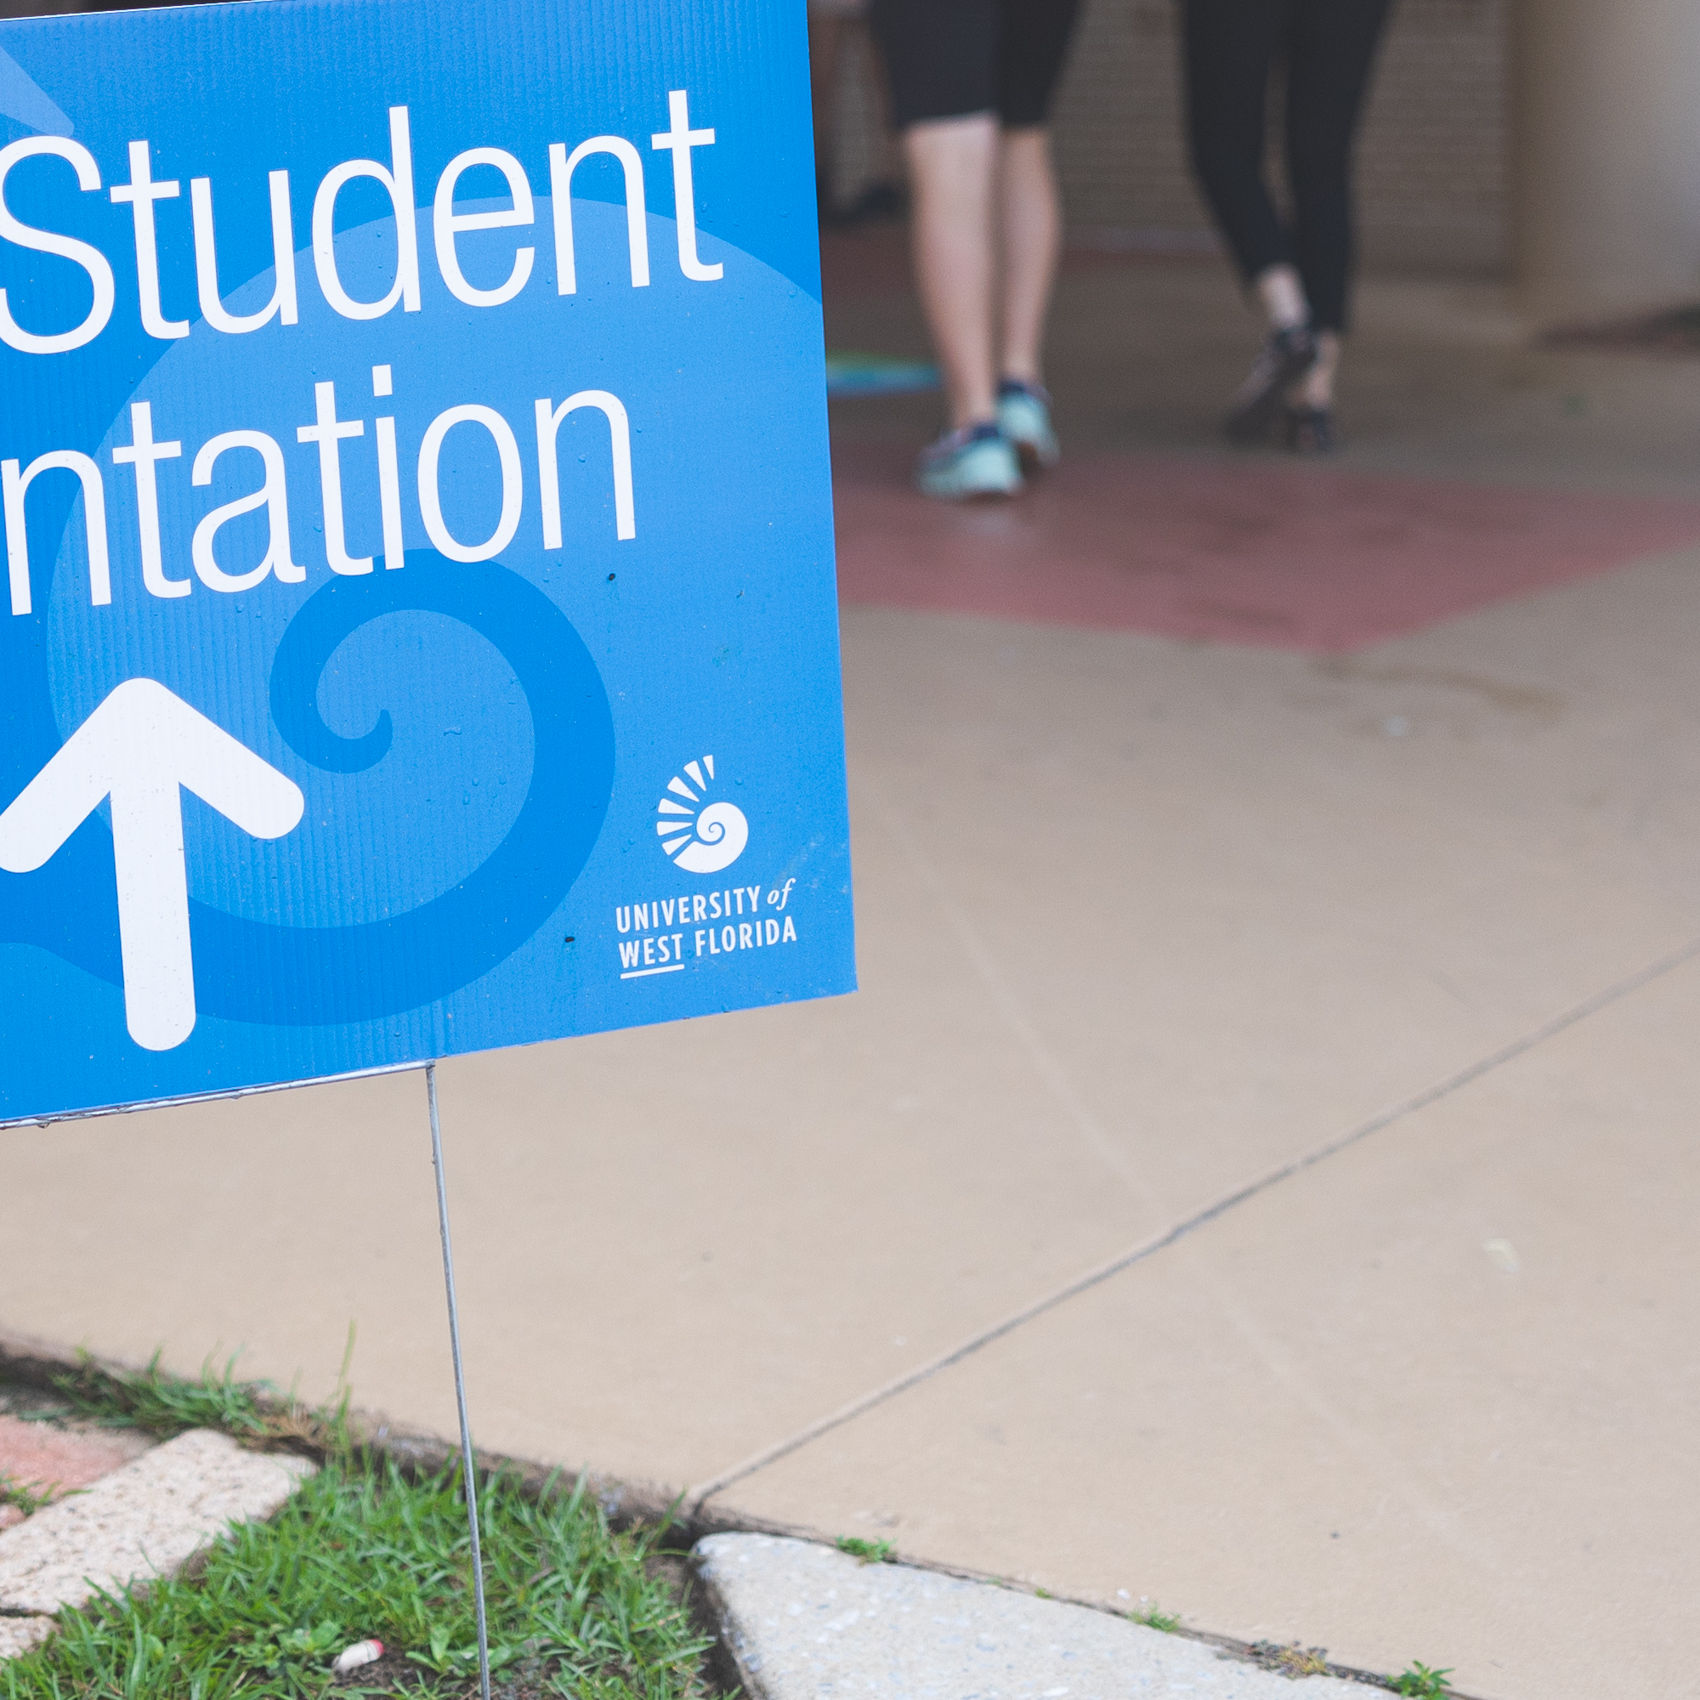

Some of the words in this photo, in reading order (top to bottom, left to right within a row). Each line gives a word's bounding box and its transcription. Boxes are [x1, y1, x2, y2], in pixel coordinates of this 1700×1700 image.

[615, 885, 761, 934] UNIVERSITY
[766, 877, 797, 911] of
[618, 933, 683, 969] WEST
[694, 915, 798, 957] FLORIDA
